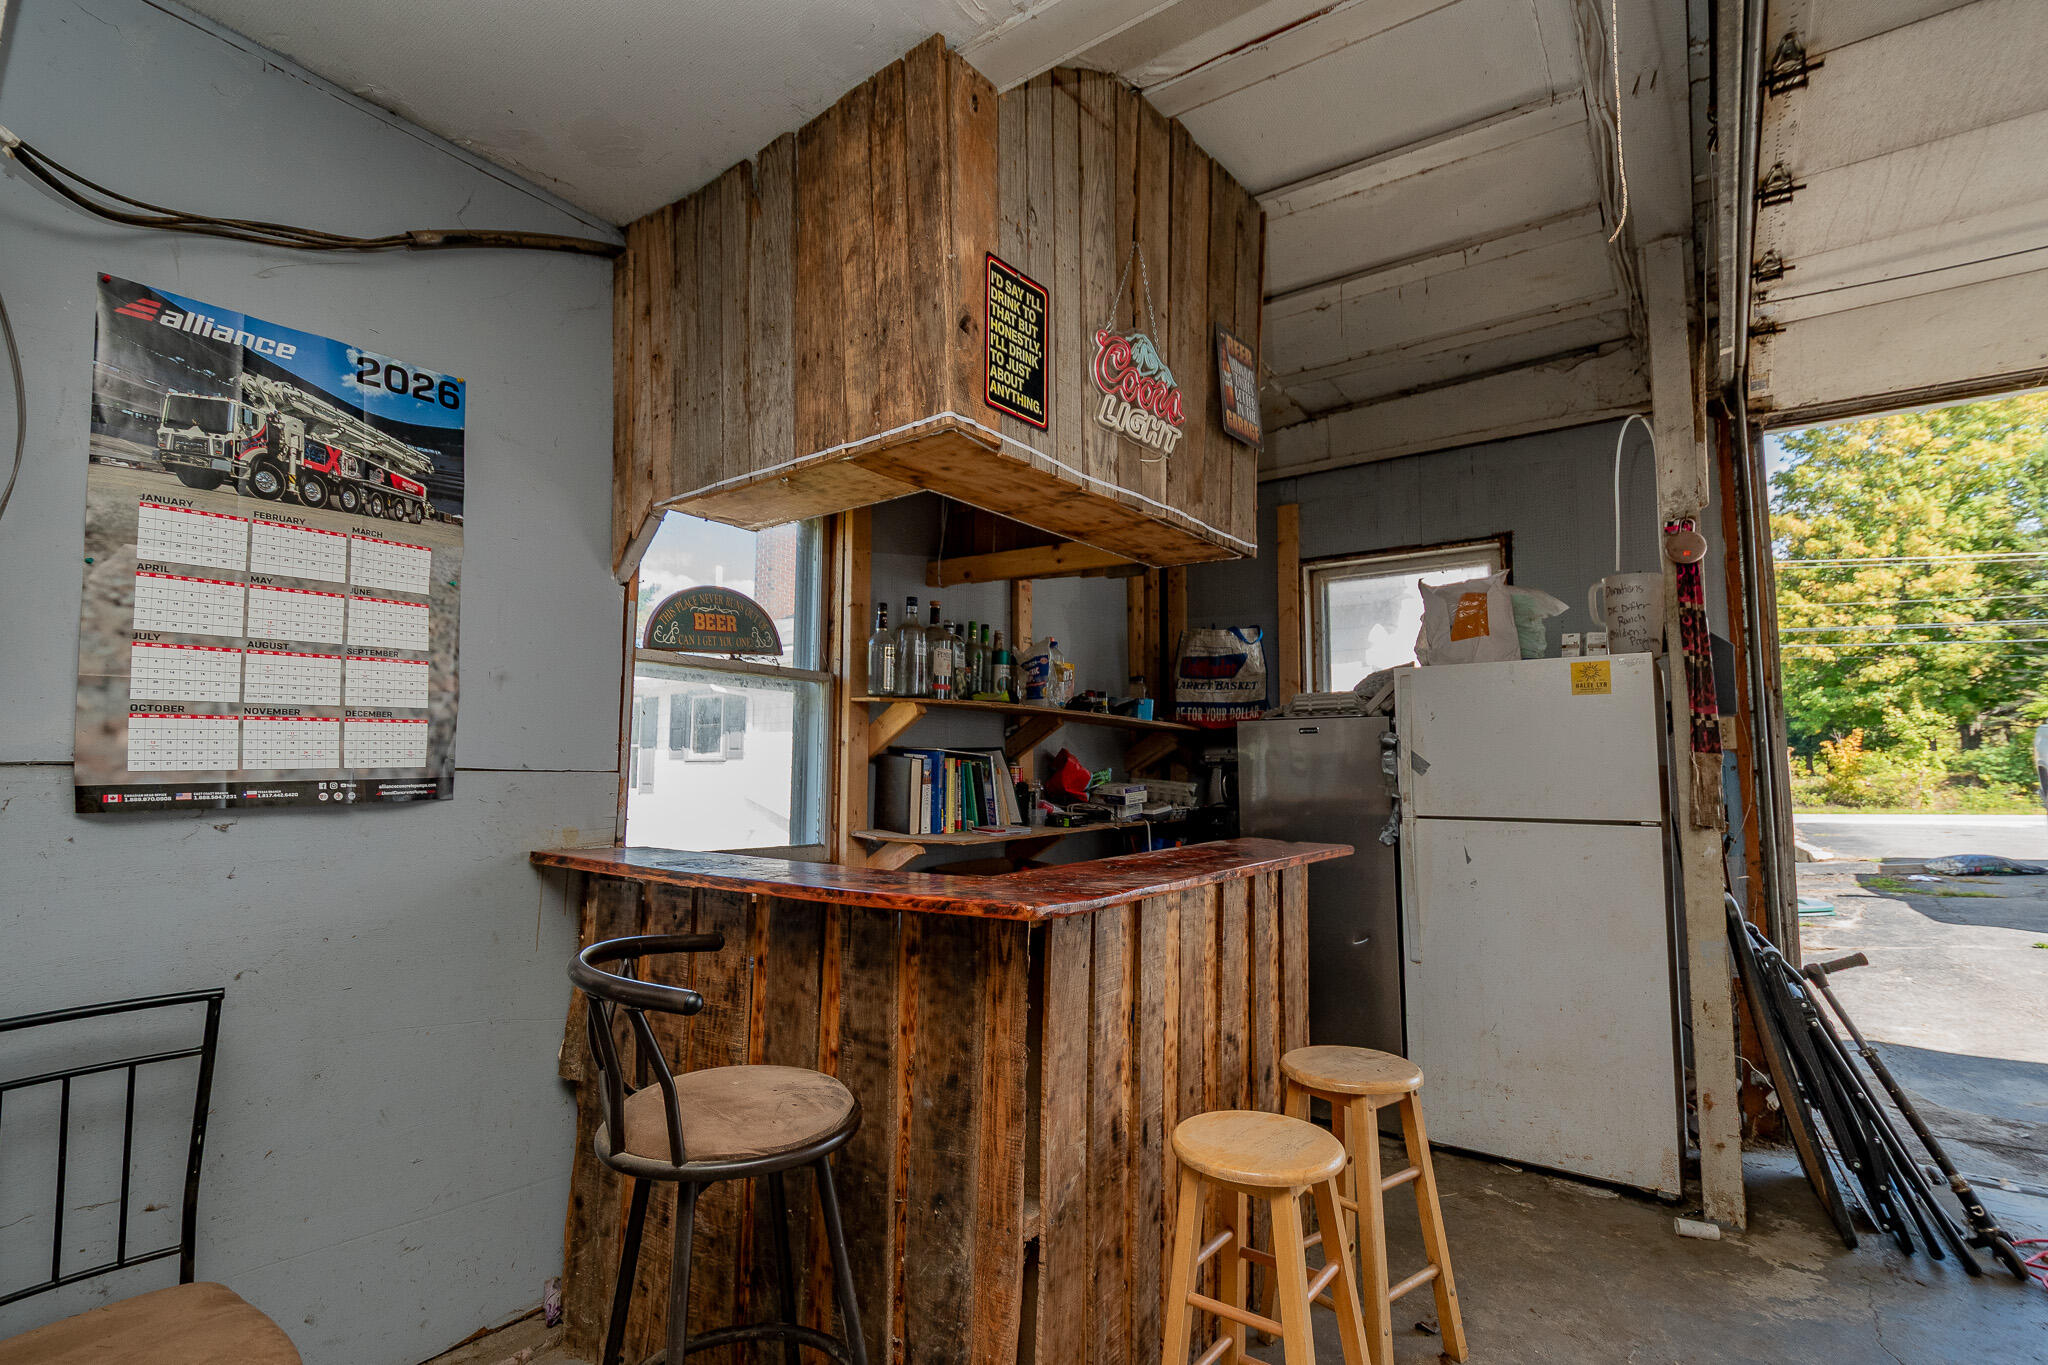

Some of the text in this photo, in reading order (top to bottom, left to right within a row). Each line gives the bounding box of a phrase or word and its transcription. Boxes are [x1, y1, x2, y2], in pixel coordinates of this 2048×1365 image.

[991, 270, 1043, 313] I'D SAY I'LL
[990, 286, 1036, 323] DRINK TO
[990, 301, 1038, 338] THAT BUT
[160, 309, 297, 360] alliance
[990, 317, 1042, 358] HONESTLY,
[990, 332, 1039, 369] I'LL DRINK
[990, 347, 1031, 380] TO JUST
[357, 357, 459, 410] 2026
[990, 364, 1024, 391] ABOUT
[1095, 330, 1185, 426] Coors
[990, 380, 1043, 415] ANYTHING.
[1099, 394, 1182, 453] LIGHT
[1226, 409, 1260, 443] GARAGE
[140, 493, 193, 508] JANUARY
[253, 511, 306, 526] FEBRUARY
[352, 527, 383, 539] MARCH
[137, 562, 170, 573] APRIL
[250, 575, 273, 585] MAY
[350, 587, 371, 596] JUNE
[659, 610, 676, 625] THIS
[674, 595, 697, 611] PLACE
[699, 593, 723, 605] NEVER
[693, 612, 737, 633] BEER
[131, 632, 161, 641] JULY
[247, 640, 289, 650] AUGUST
[678, 635, 694, 646] CAN
[697, 635, 701, 646] I
[702, 635, 717, 647] GET
[719, 636, 732, 647] YOU
[346, 648, 399, 658] SEPTEMBER
[1215, 680, 1257, 690] BASKET
[130, 703, 185, 713] OCTOBER
[243, 707, 301, 716] NOVEMBER
[345, 710, 393, 719] DECEMBER
[1187, 707, 1203, 721] FOR
[1205, 707, 1227, 722] YOUR
[1230, 705, 1260, 720] DOLLAR
